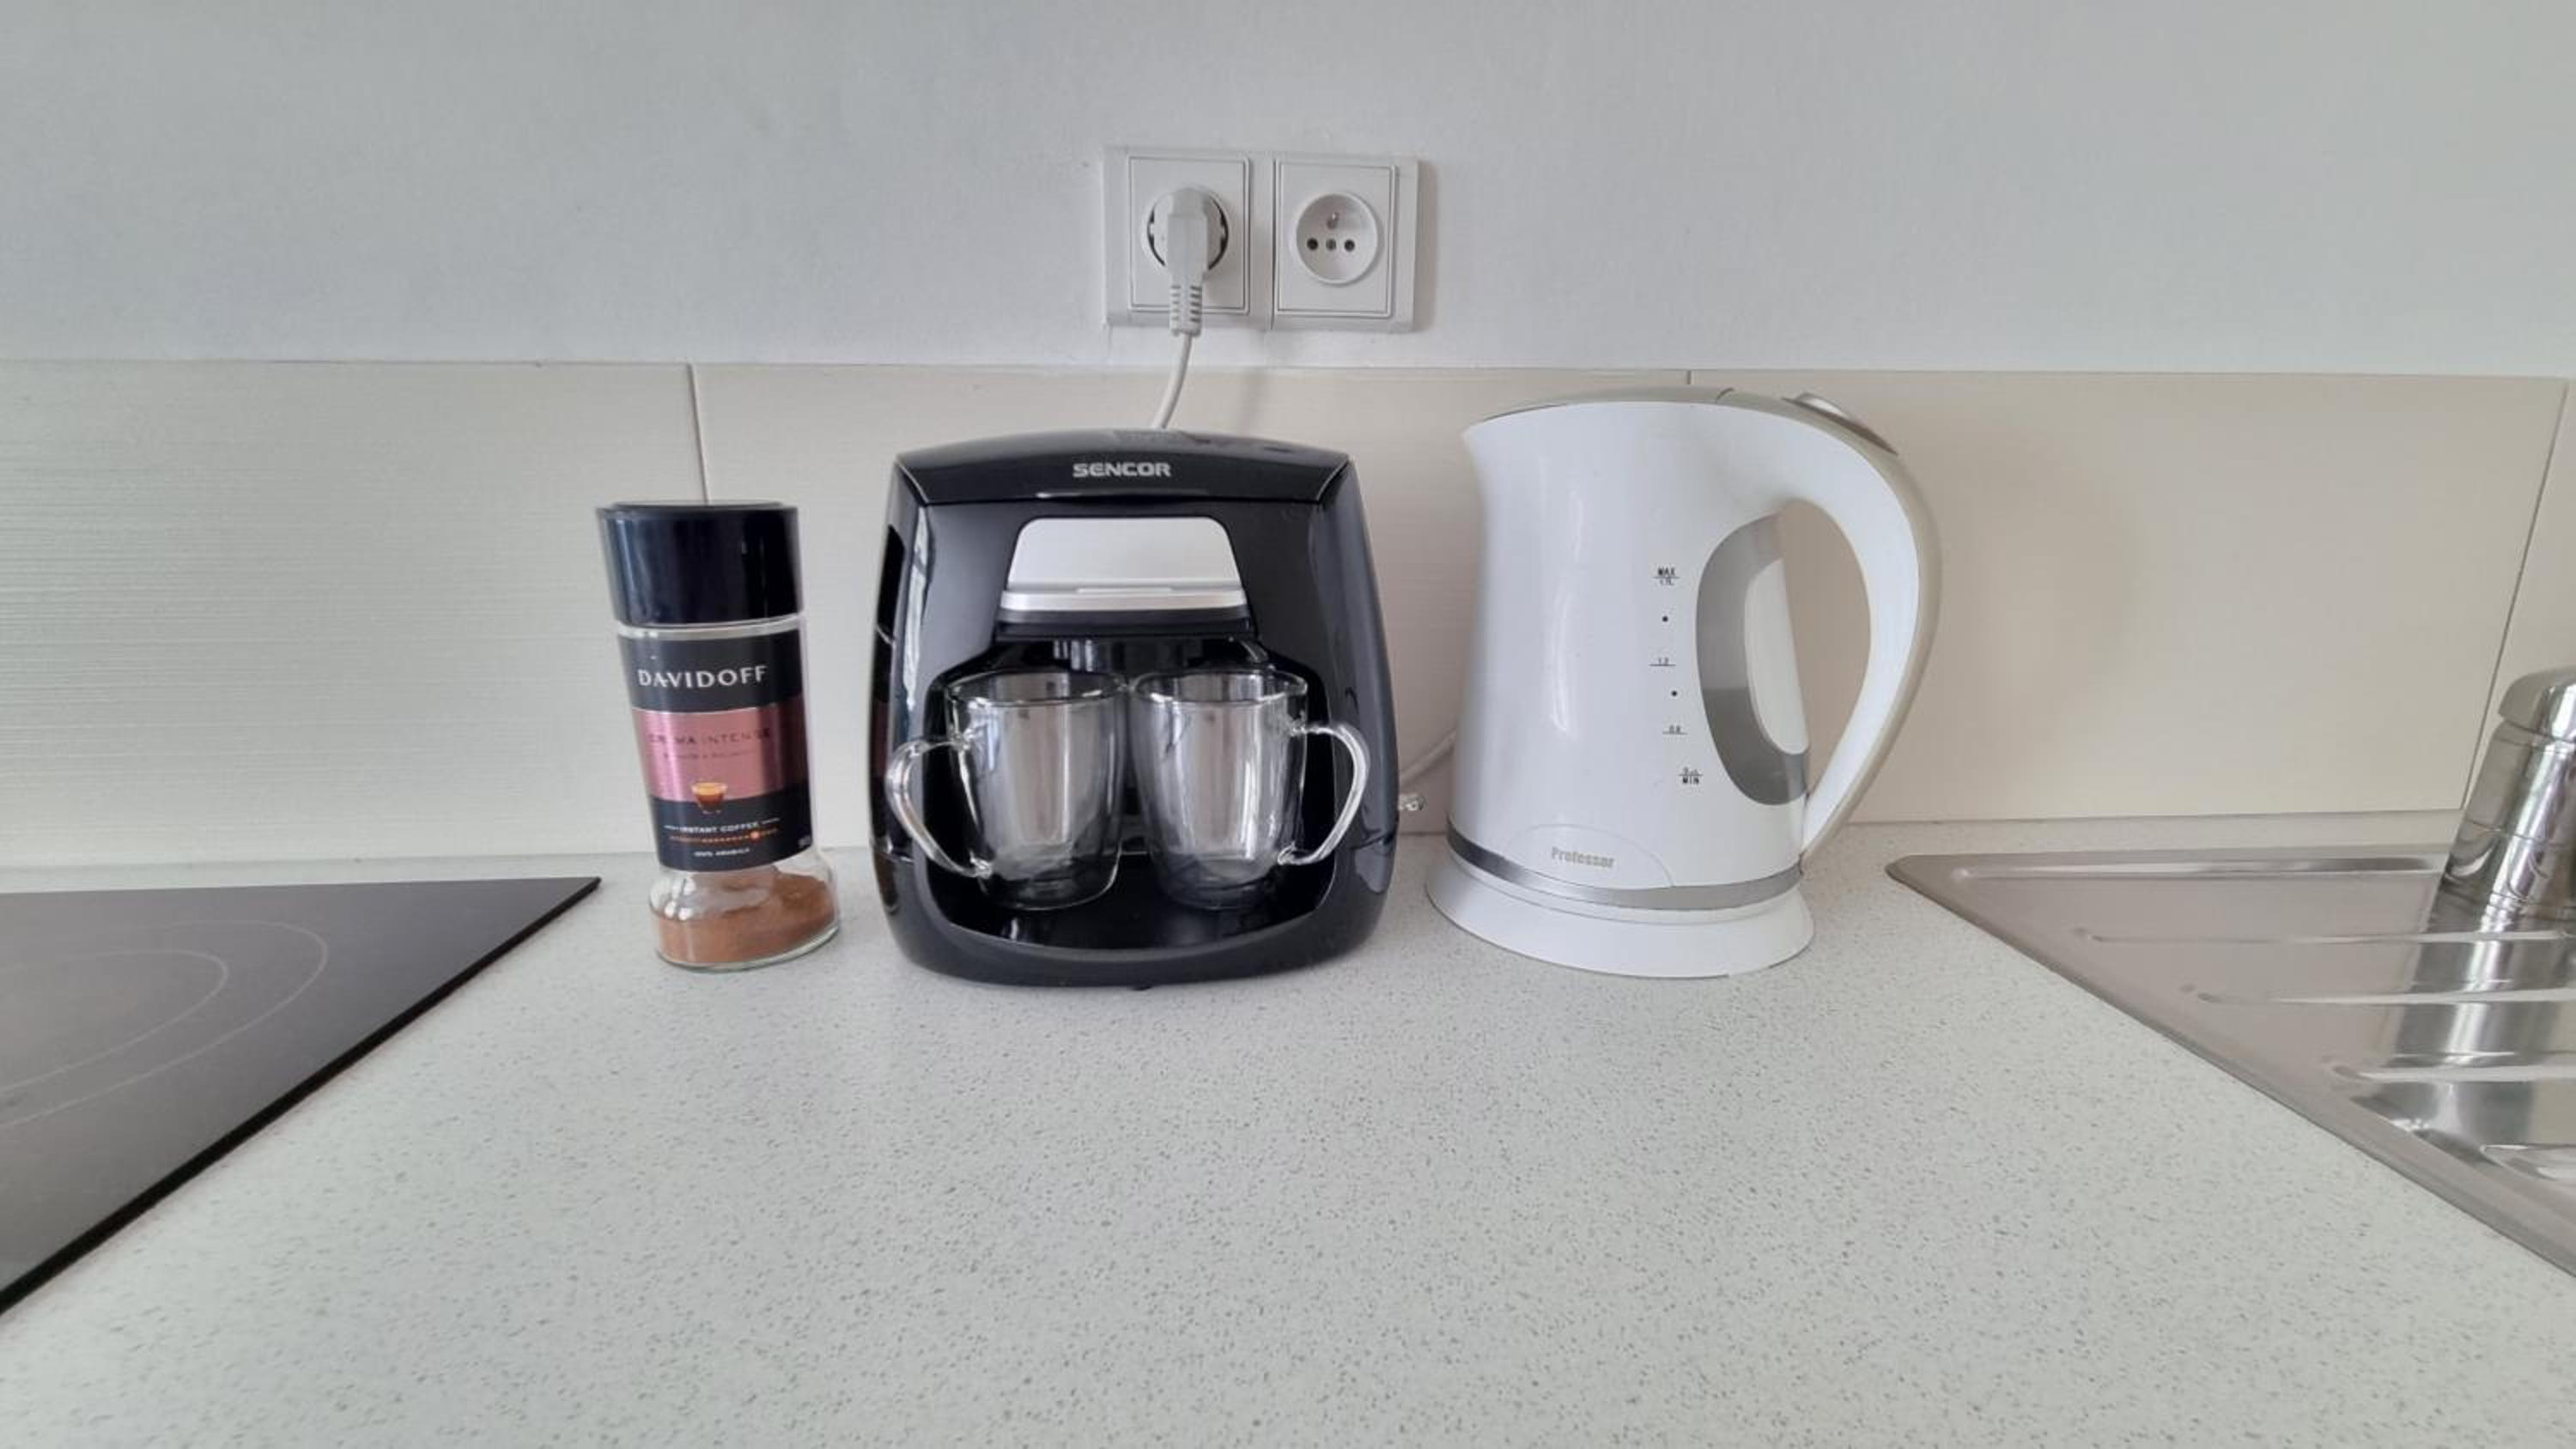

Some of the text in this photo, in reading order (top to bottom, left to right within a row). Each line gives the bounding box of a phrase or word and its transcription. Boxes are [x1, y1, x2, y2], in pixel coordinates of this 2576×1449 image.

[1072, 462, 1172, 477] SENCOR
[1658, 567, 1675, 577] MAX
[637, 665, 768, 688] DAVIDOFF
[647, 734, 696, 744] CRMA
[1683, 776, 1699, 785] MIN
[720, 821, 759, 833] COFFEE
[1552, 846, 1615, 869] Professor
